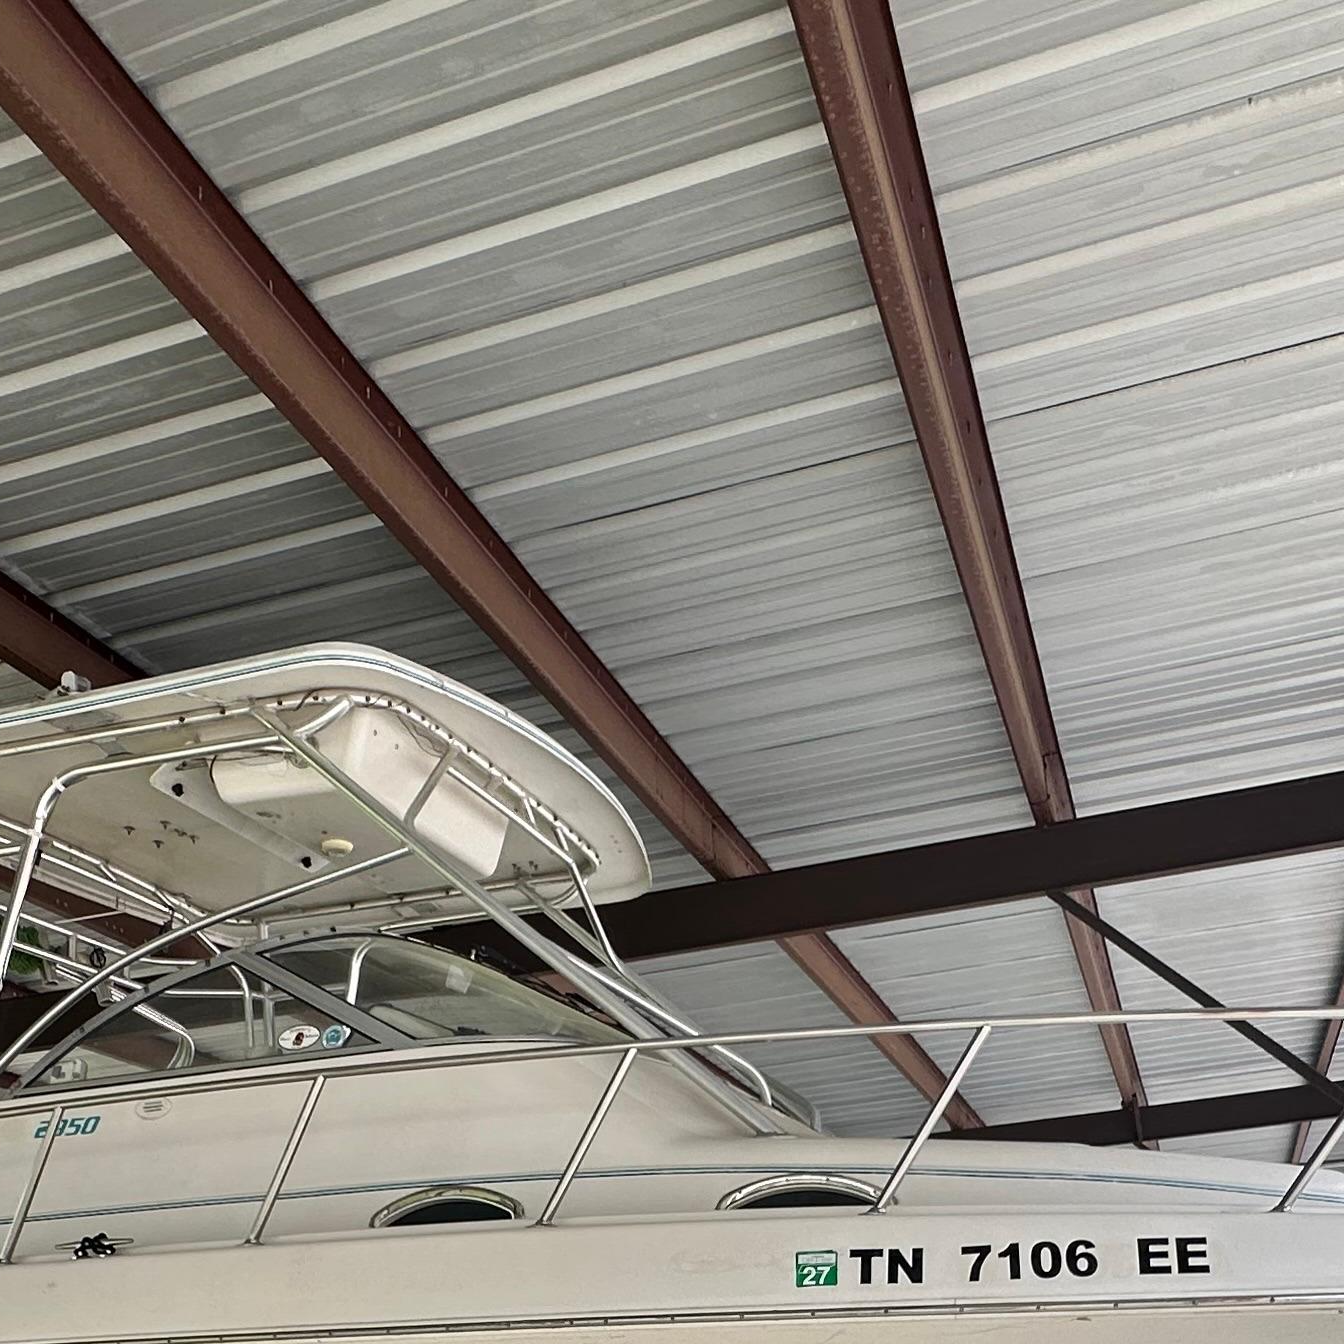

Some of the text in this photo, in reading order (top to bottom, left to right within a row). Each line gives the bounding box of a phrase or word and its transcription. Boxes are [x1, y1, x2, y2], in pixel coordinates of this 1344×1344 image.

[802, 1266, 831, 1286] 27
[849, 1236, 1211, 1285] TN 7106 EE
